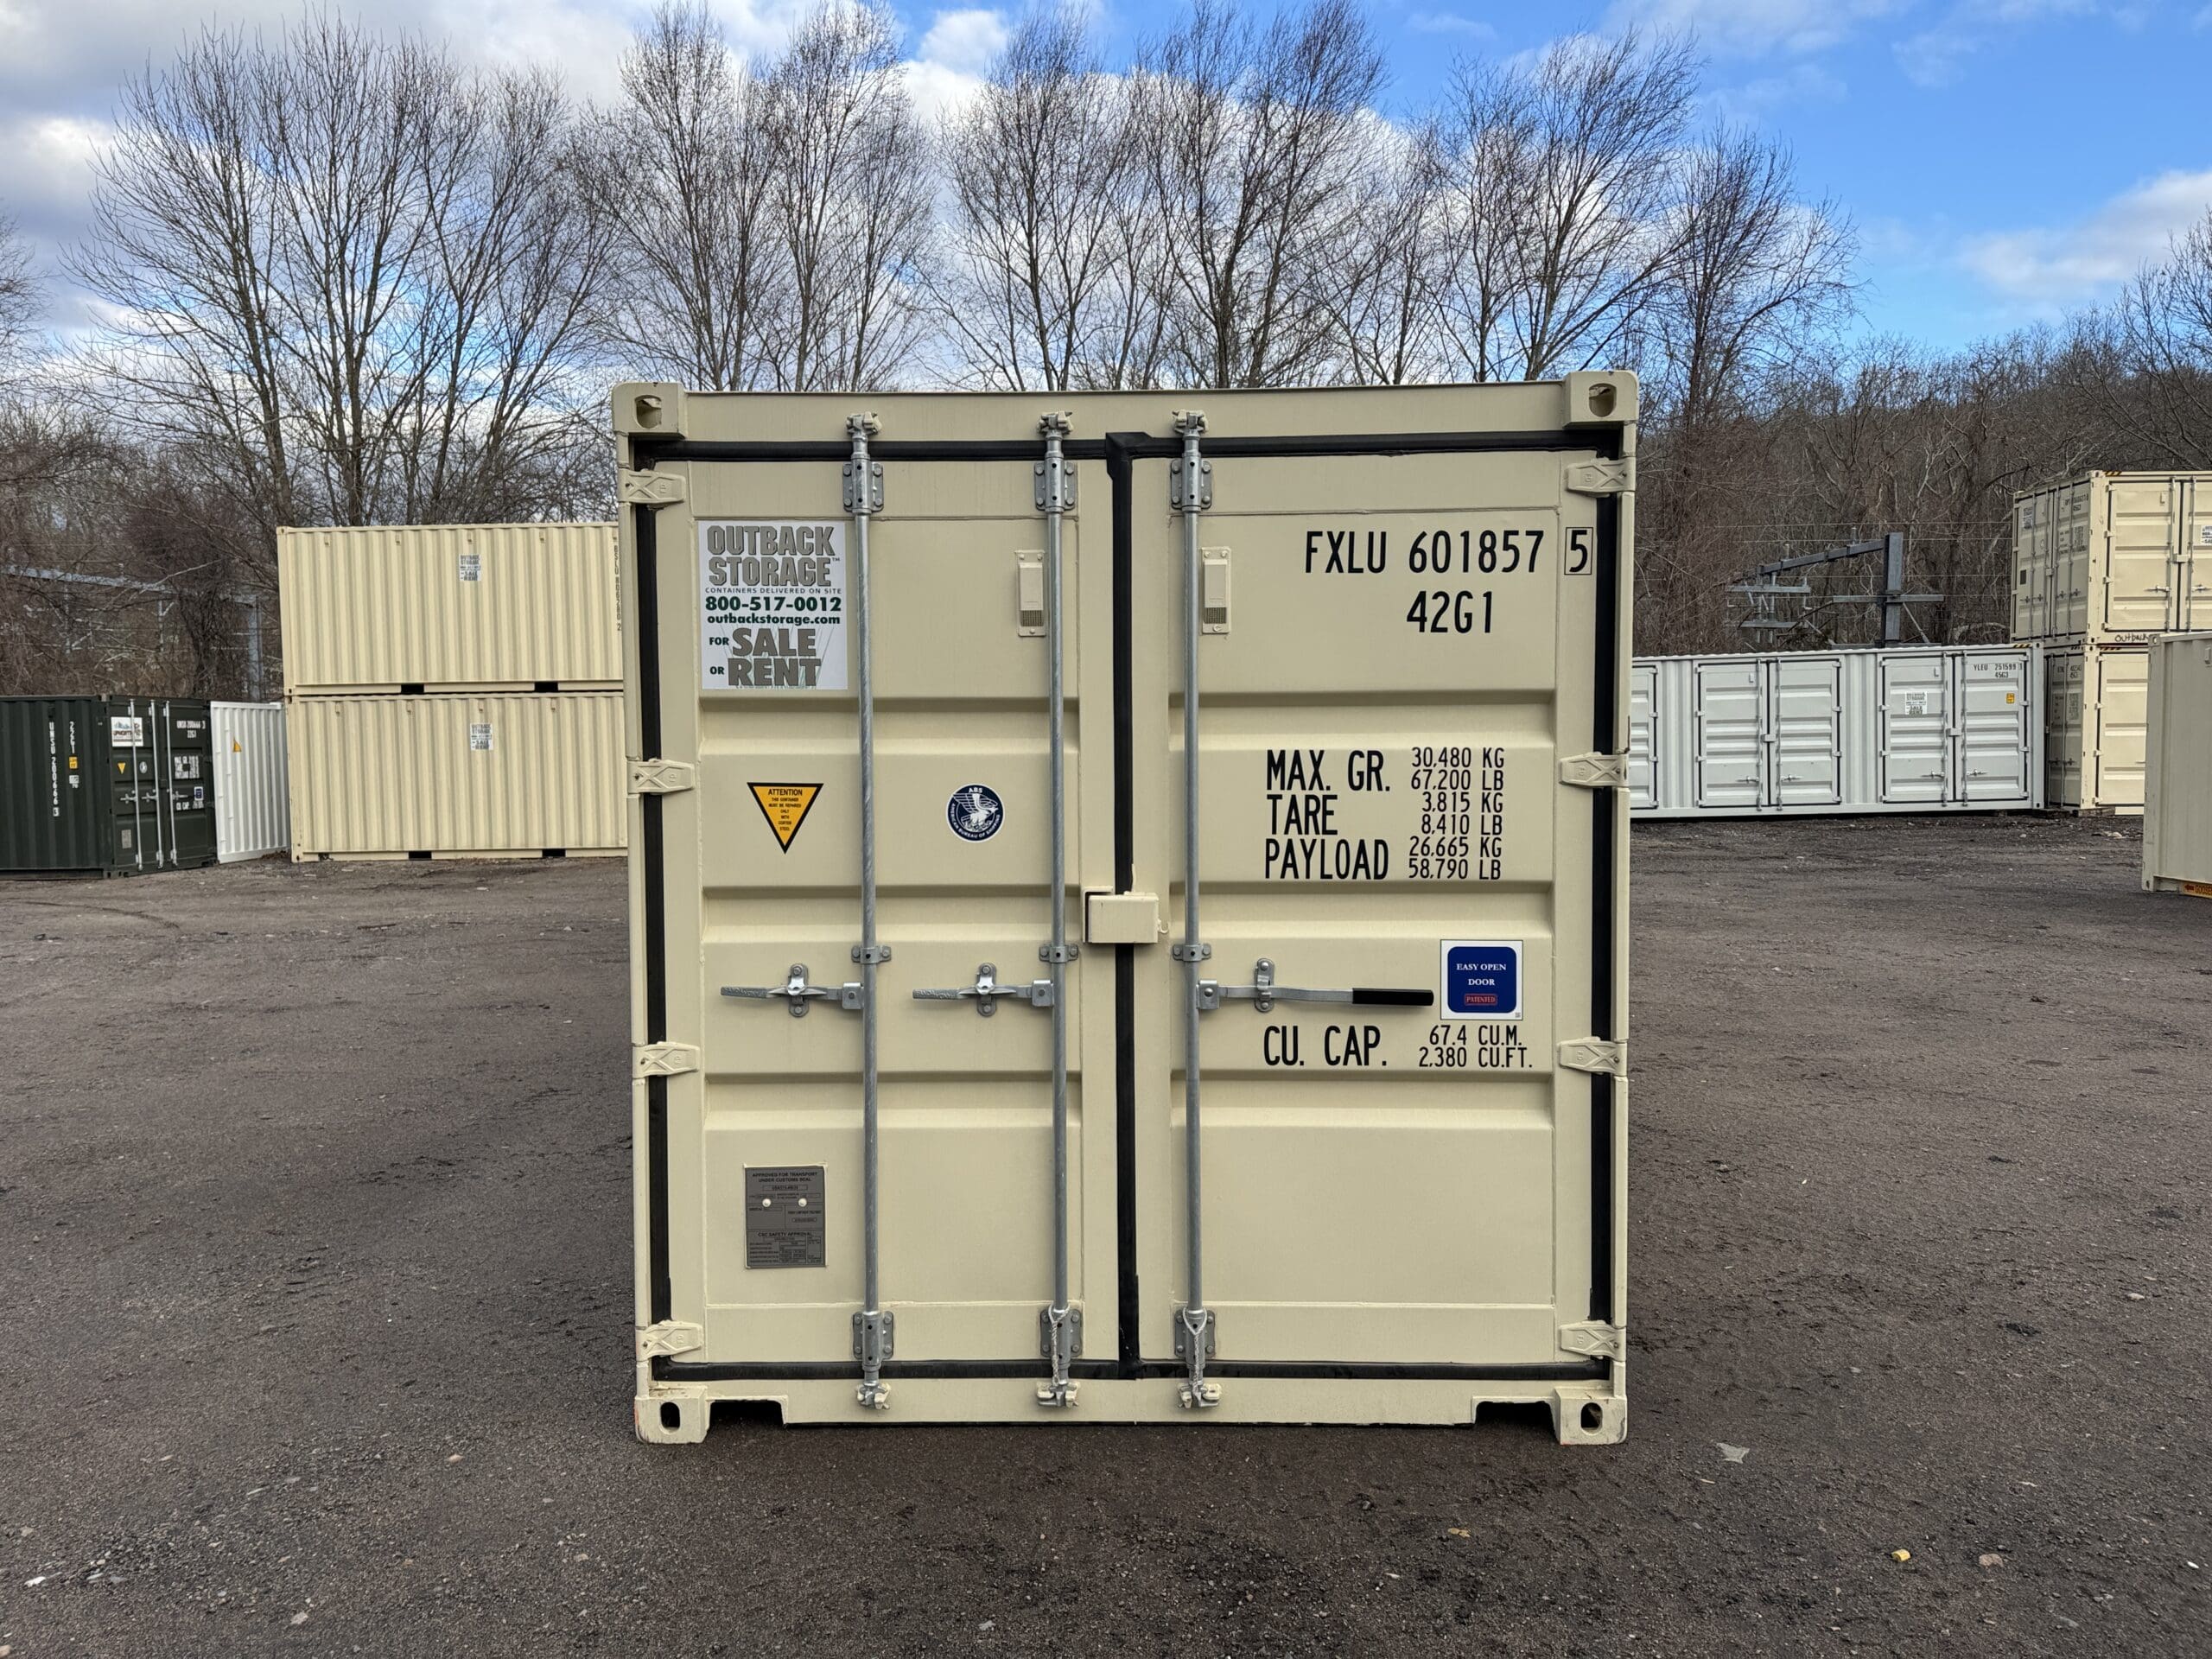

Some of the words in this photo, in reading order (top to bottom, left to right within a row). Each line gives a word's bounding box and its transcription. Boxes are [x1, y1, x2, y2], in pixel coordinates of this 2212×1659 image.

[707, 525, 836, 556] OUTBACK
[1305, 531, 1387, 574] FXLU
[1408, 530, 1544, 574] 601857
[1568, 530, 1588, 573] 5
[709, 556, 831, 587] STORAGE
[705, 596, 842, 611] 800-517-0012
[1406, 590, 1492, 633] 42G1
[708, 613, 840, 626] outbackstorage.com
[709, 637, 729, 645] FOR
[732, 627, 817, 657] SALE
[709, 666, 725, 675] OR
[728, 658, 822, 686] RENT
[1267, 749, 1331, 791] MAX.
[1348, 750, 1390, 791] GR.
[1411, 747, 1471, 768] 30,480
[1483, 747, 1504, 768] KG
[1411, 769, 1471, 790] 67,200
[1482, 770, 1503, 791] LB
[1267, 794, 1338, 835] TARE
[1422, 791, 1470, 813] 3,815
[1481, 791, 1503, 813] KG
[1421, 814, 1470, 835] 8,410
[1480, 815, 1503, 836] LB
[1265, 838, 1389, 880] PAYLOAD
[1409, 836, 1468, 857] 26,665
[1480, 836, 1502, 858] KG
[1408, 858, 1468, 879] 58,790
[1479, 859, 1501, 880] LB
[1263, 1025, 1305, 1066] CU.
[1324, 1025, 1387, 1066] CAP.
[1429, 1025, 1467, 1046] 67.4
[1478, 1025, 1522, 1046] CU.M.
[1419, 1046, 1467, 1068] 2,380
[1478, 1046, 1533, 1068] CU.FT.
